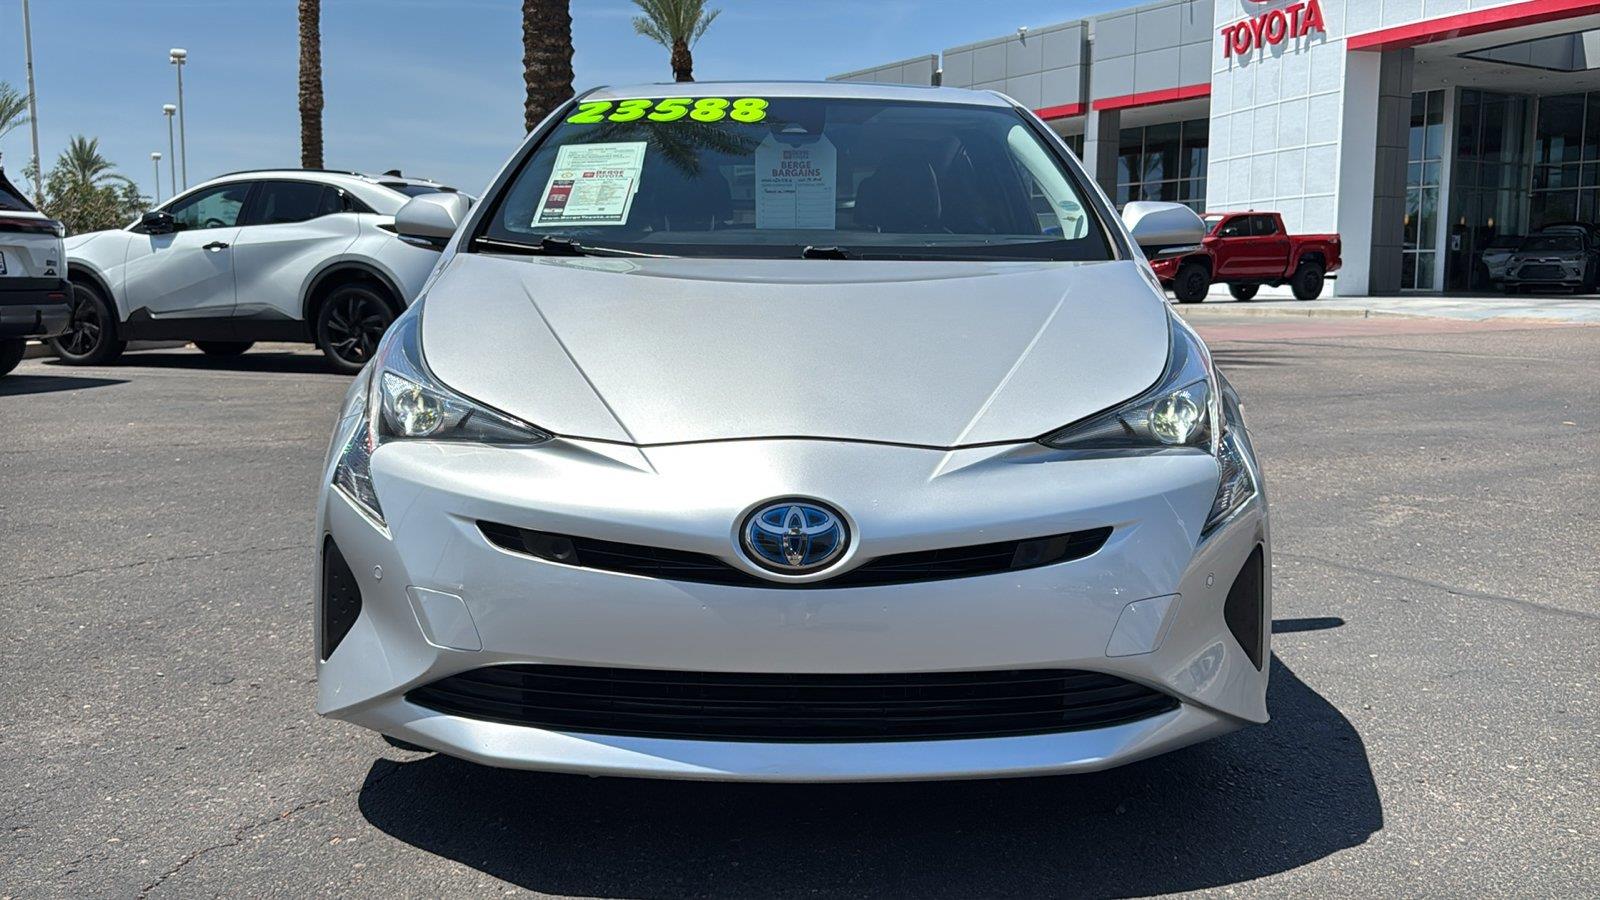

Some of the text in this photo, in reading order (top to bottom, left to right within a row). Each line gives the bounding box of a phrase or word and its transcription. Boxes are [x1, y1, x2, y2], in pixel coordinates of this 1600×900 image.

[1221, 0, 1325, 58] TOYOTA
[566, 97, 769, 123] 23588
[772, 169, 821, 177] BARGAINS
[781, 161, 812, 169] BERGE
